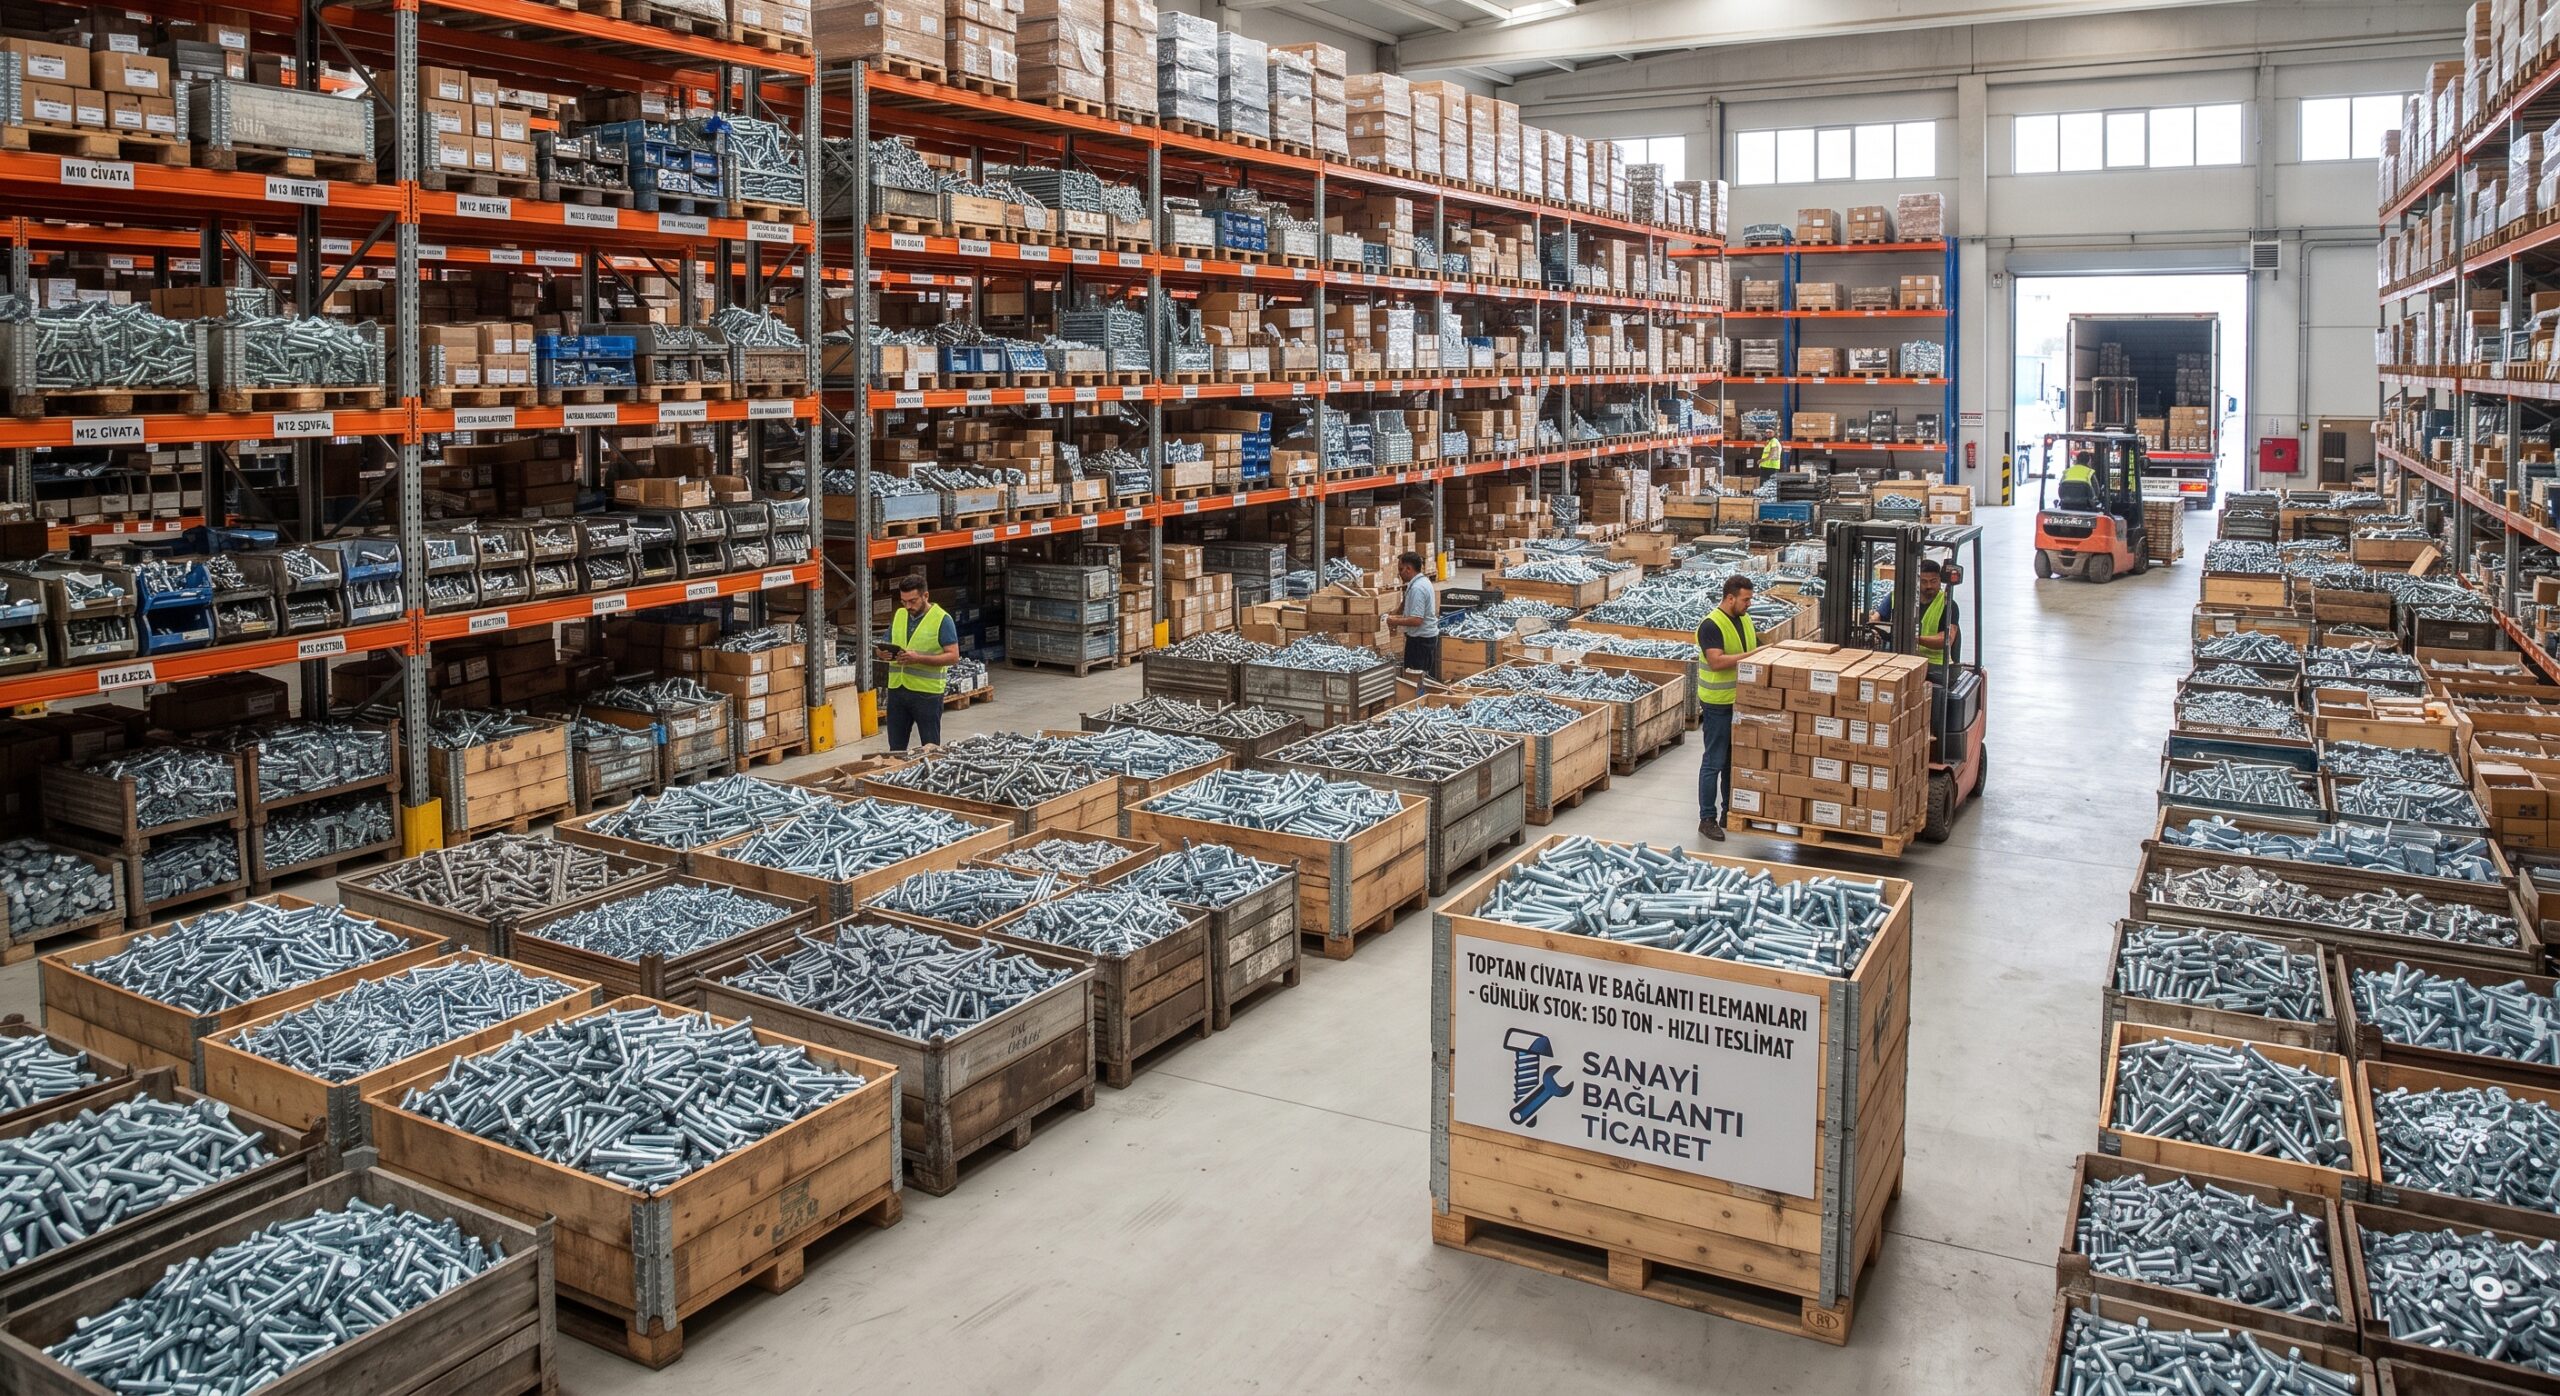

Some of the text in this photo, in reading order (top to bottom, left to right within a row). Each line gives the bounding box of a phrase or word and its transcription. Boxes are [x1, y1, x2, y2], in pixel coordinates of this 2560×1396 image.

[66, 164, 130, 182] M10 CİVATA
[76, 428, 97, 439] M12
[1467, 952, 1807, 1032] TOPTAN CİVATA VE BAĞLANTI ELEMANLARI
[1479, 982, 1540, 1014] GÜNLÜK
[1543, 996, 1587, 1022] STOK:
[1592, 1005, 1617, 1027] 150
[1621, 1009, 1653, 1034] TON
[1668, 1018, 1709, 1045] HIZLI
[1714, 1026, 1794, 1060] TESLİMAT
[1582, 1051, 1699, 1096] SANAYİ
[1583, 1082, 1743, 1138] BAĞLANTI
[1581, 1111, 1711, 1162] TİCARET
